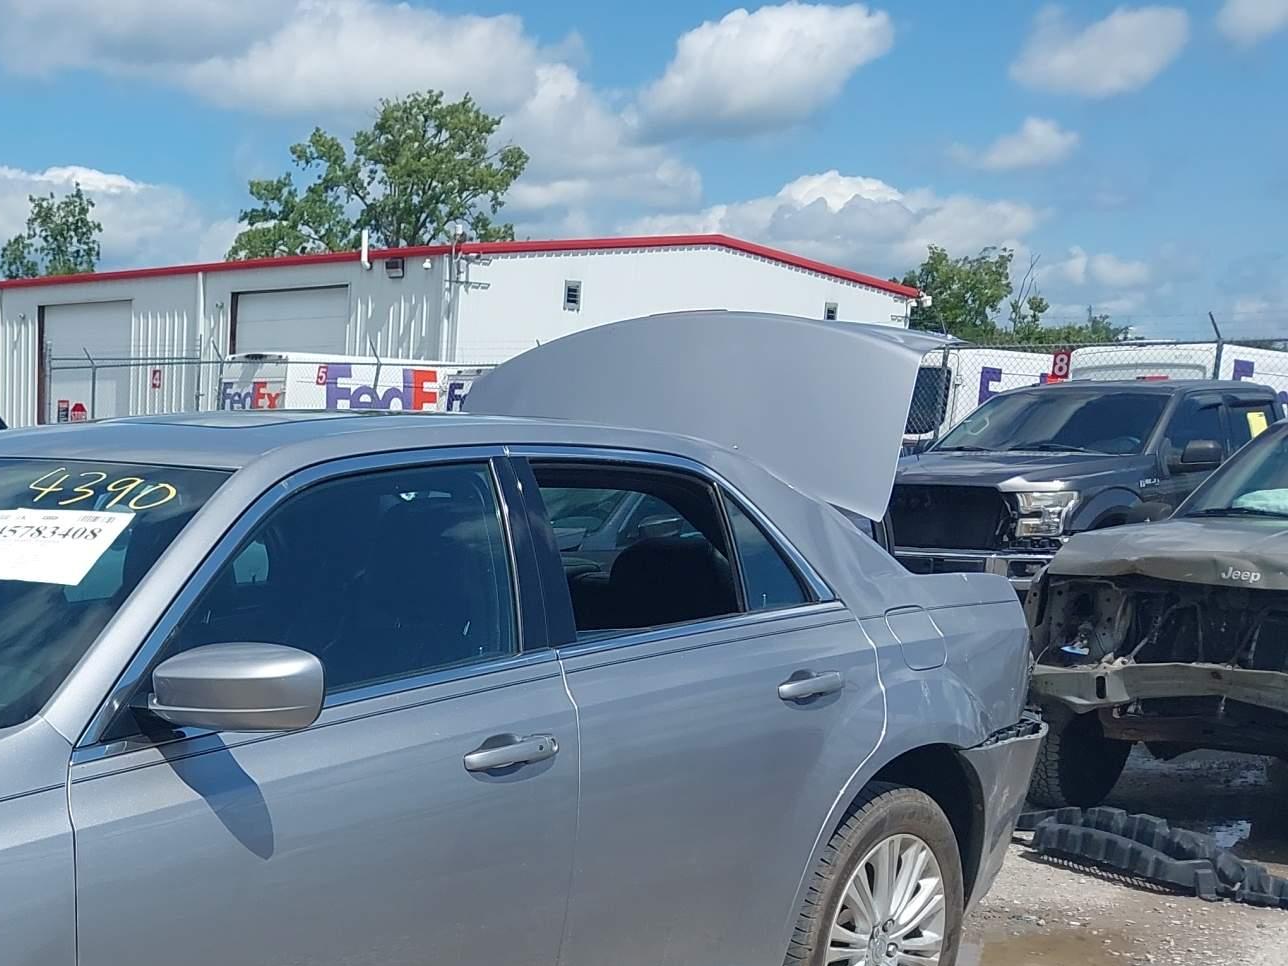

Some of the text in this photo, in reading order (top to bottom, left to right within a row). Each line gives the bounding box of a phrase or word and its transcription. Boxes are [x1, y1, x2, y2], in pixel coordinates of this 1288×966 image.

[317, 367, 327, 384] 5
[1053, 353, 1068, 377] 8
[152, 370, 161, 388] 4
[221, 381, 280, 410] FedEx
[29, 467, 176, 509] 4390
[1221, 566, 1261, 584] Jeep
